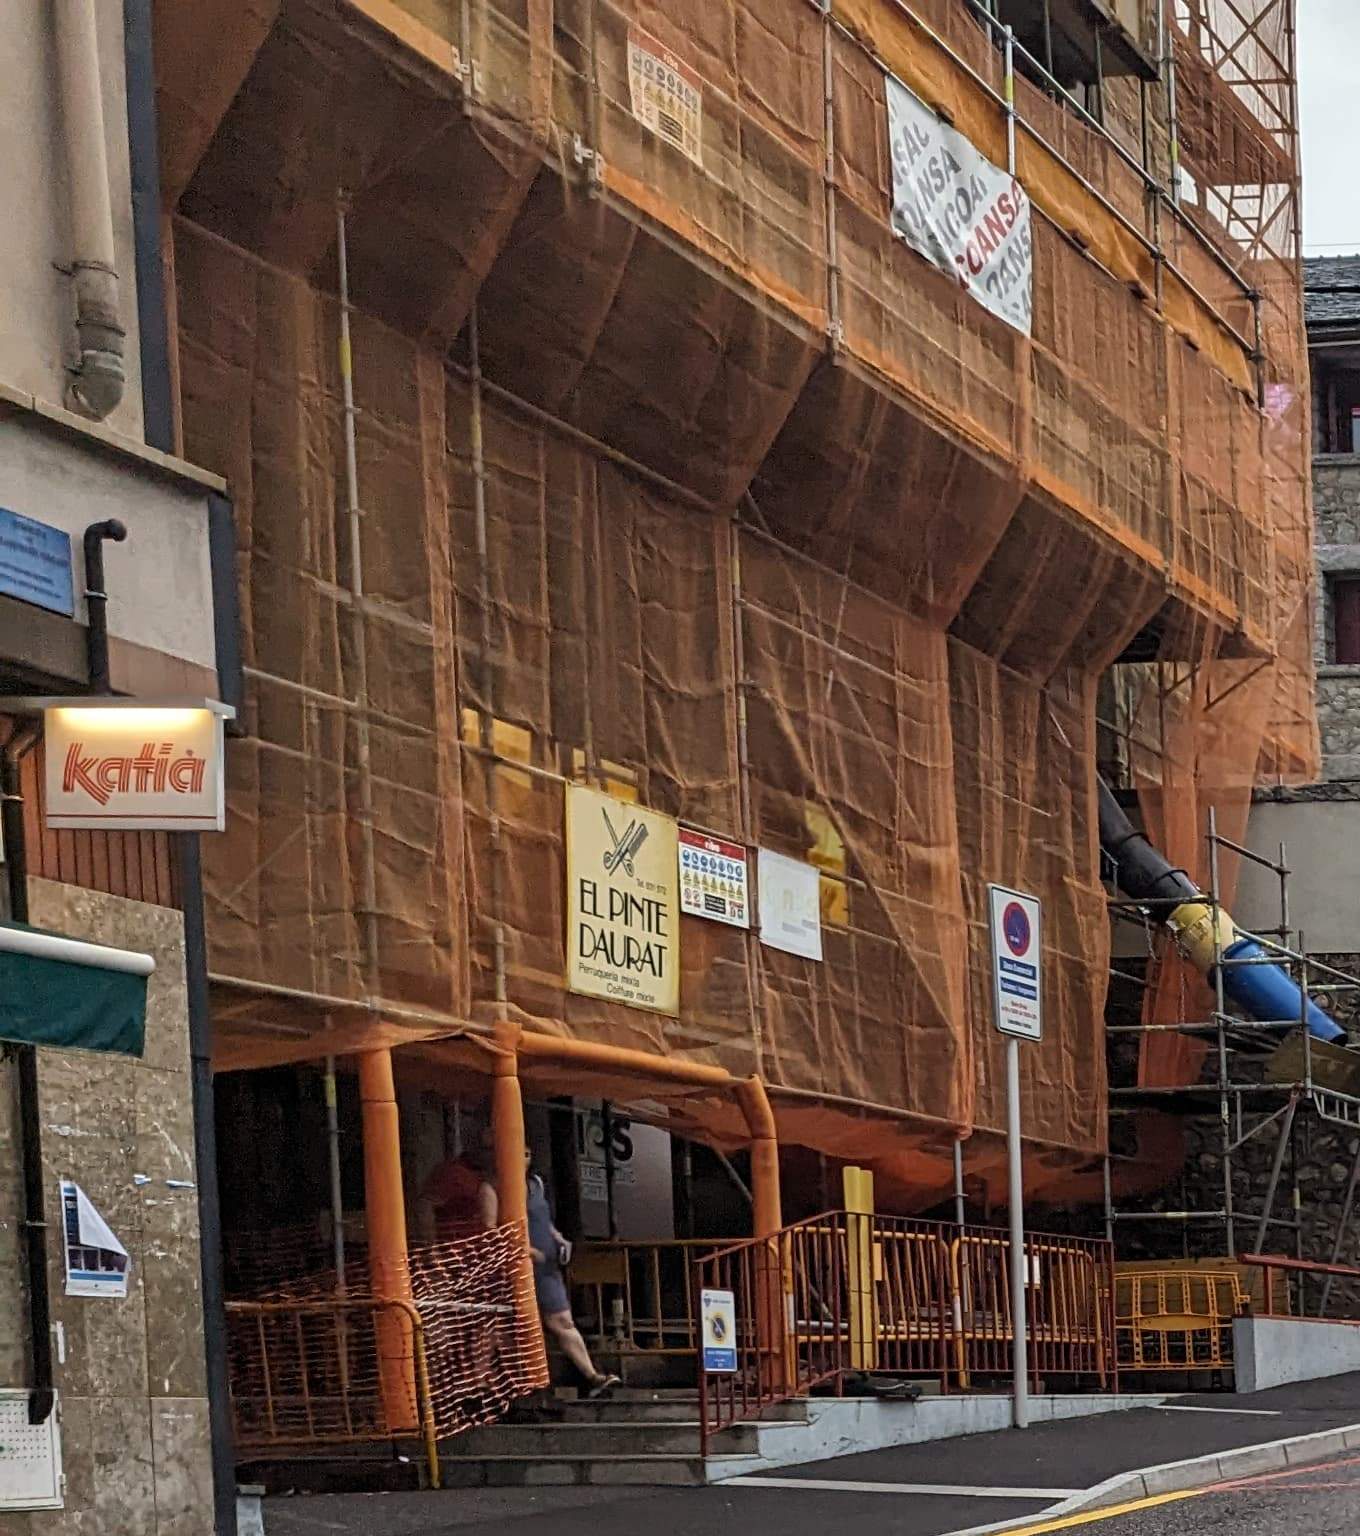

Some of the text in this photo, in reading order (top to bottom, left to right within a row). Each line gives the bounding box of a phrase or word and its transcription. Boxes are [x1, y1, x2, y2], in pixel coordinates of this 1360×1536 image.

[580, 878, 605, 919] EL
[608, 886, 669, 938] PINTE
[580, 922, 668, 978] DAURAT
